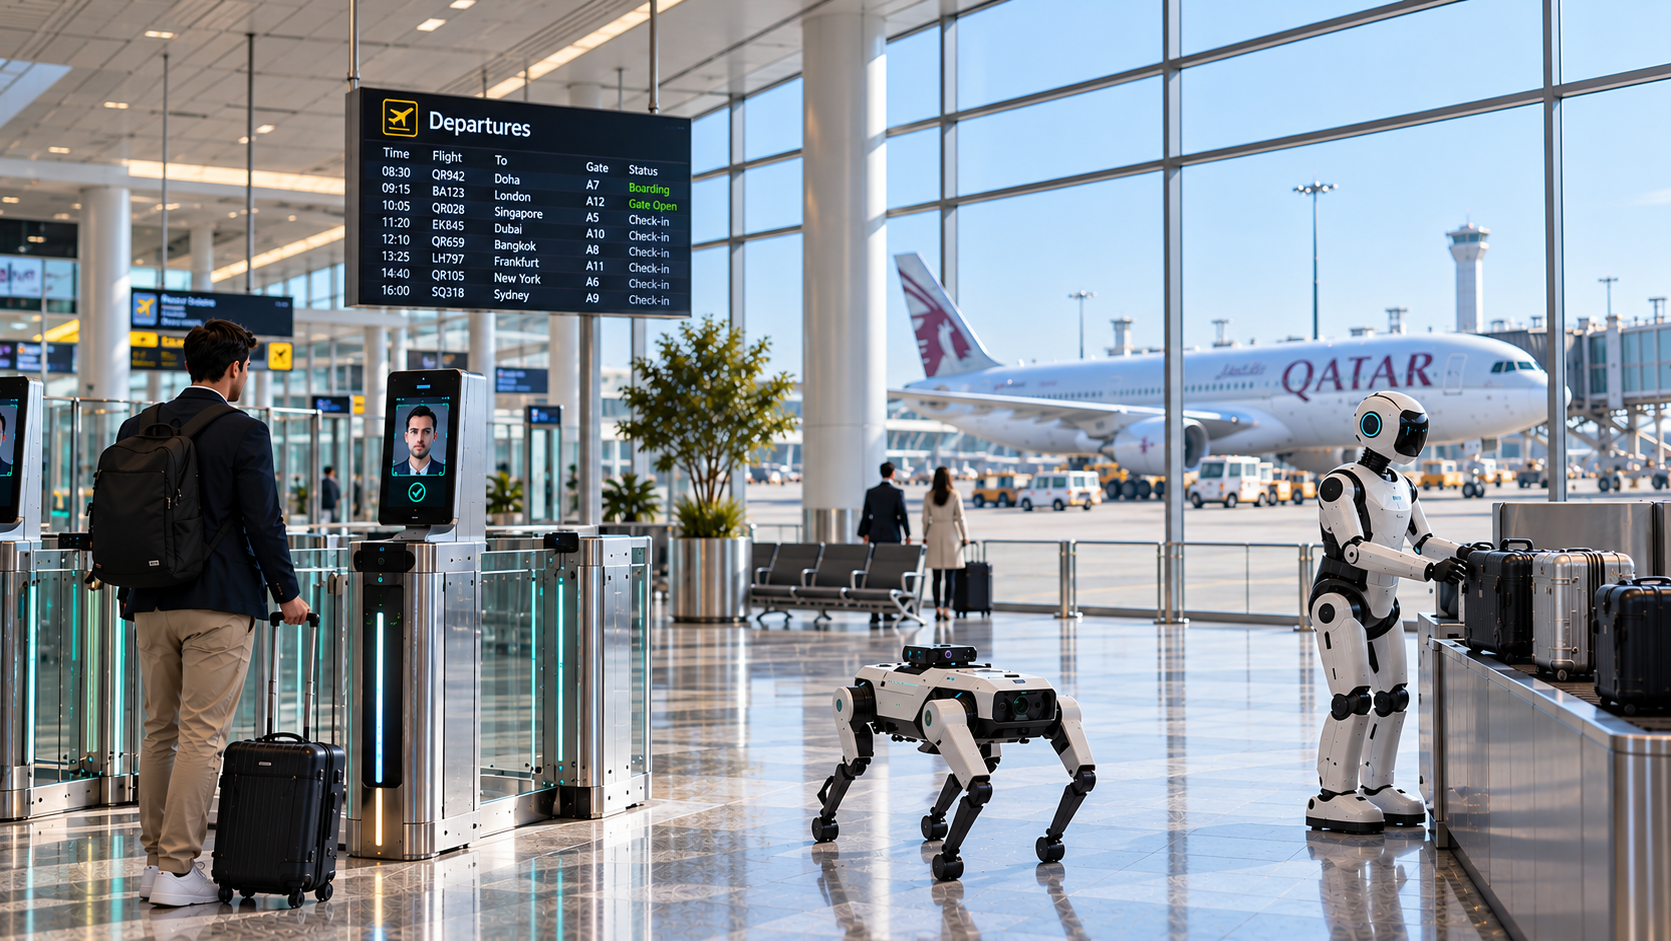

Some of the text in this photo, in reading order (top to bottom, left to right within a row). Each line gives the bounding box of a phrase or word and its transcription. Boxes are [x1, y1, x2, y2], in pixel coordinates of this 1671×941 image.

[429, 110, 531, 138] Departures
[382, 146, 659, 177] Time Flight To Gate Status
[381, 165, 670, 198] 08:30 QR942 Doha A7 Boarding
[381, 182, 678, 213] 09:15 BA123 London A12 Gate Open
[382, 199, 670, 227] 10:05 QR028 Singapore A5 Check-in
[382, 216, 670, 243] 11:20 EK845 Dubai A10 Check-in
[381, 233, 670, 259] 12:10 QR659 Bangkok A8 Check-in
[381, 250, 670, 275] 13:25 LH797 Frankfurt A11 Check-in
[381, 267, 670, 290] 14:40 QR105 New York A6 Check-in
[381, 284, 670, 306] 16:00 SQ318 Sydney A9 Check-in
[1281, 351, 1434, 402] QATAR
